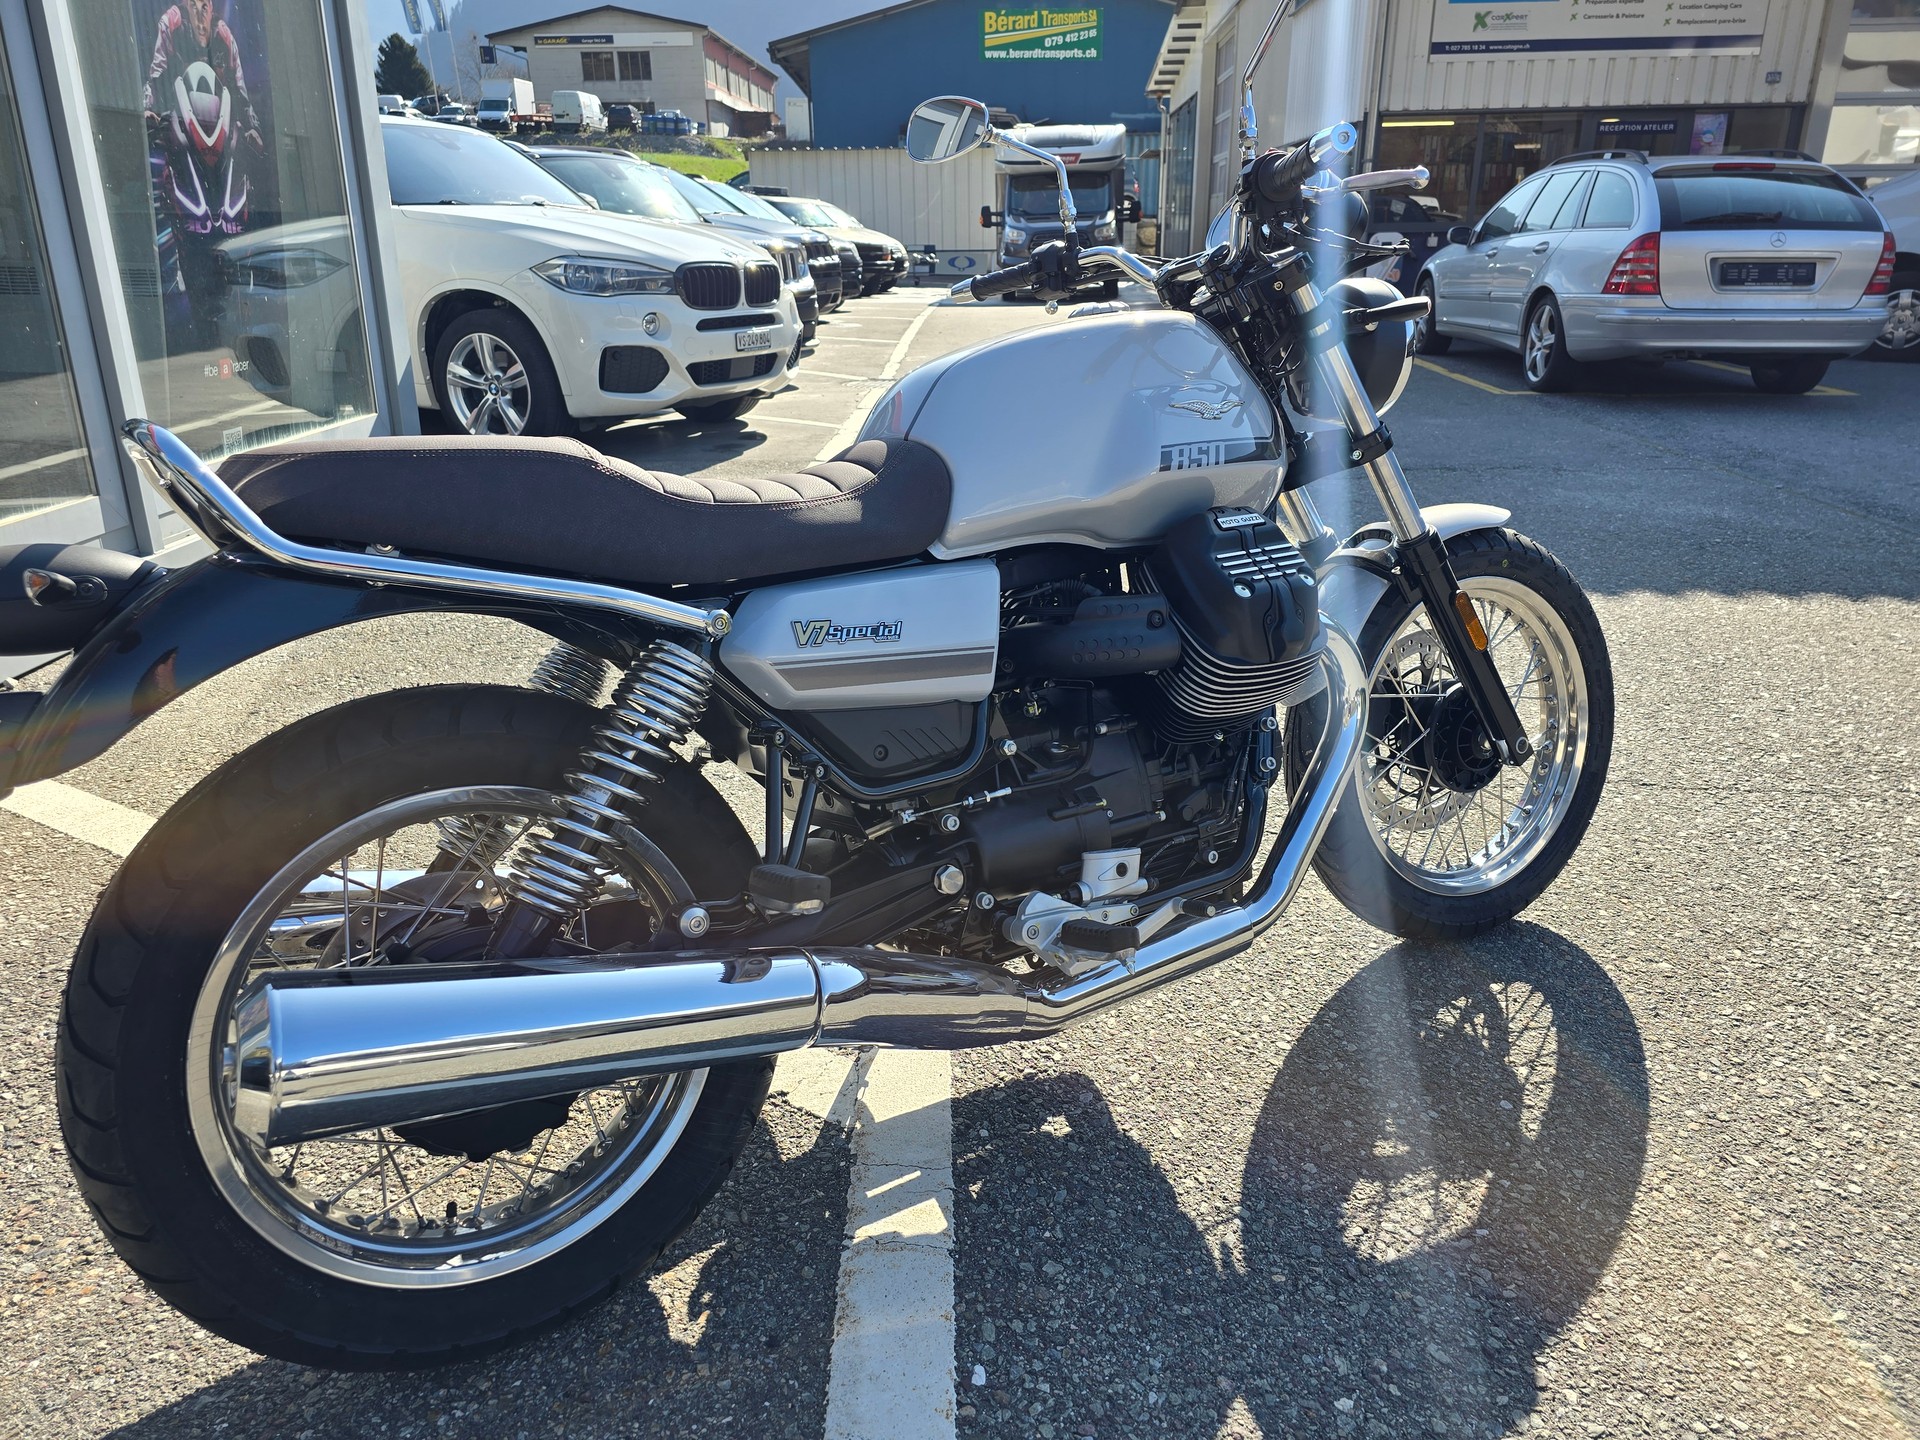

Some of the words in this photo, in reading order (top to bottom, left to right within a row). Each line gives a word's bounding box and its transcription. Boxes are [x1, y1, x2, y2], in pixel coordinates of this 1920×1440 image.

[1704, 3, 1728, 11] Camping
[984, 10, 1038, 33] Bérard
[1041, 10, 1088, 27] Transports
[1088, 9, 1098, 22] SA
[1676, 18, 1717, 26] Remplacement
[1044, 36, 1064, 47] 079
[1065, 33, 1079, 43] 412
[1079, 30, 1089, 40] 23
[984, 48, 1097, 60] www.berardtransports.ch
[1599, 124, 1642, 132] RECEPTION
[1643, 123, 1674, 131] ATELIER
[204, 363, 218, 378] #be
[232, 360, 250, 373] racer
[1170, 441, 1225, 471] 850
[1220, 518, 1240, 526] MOTO
[1241, 515, 1262, 524] GUZZI
